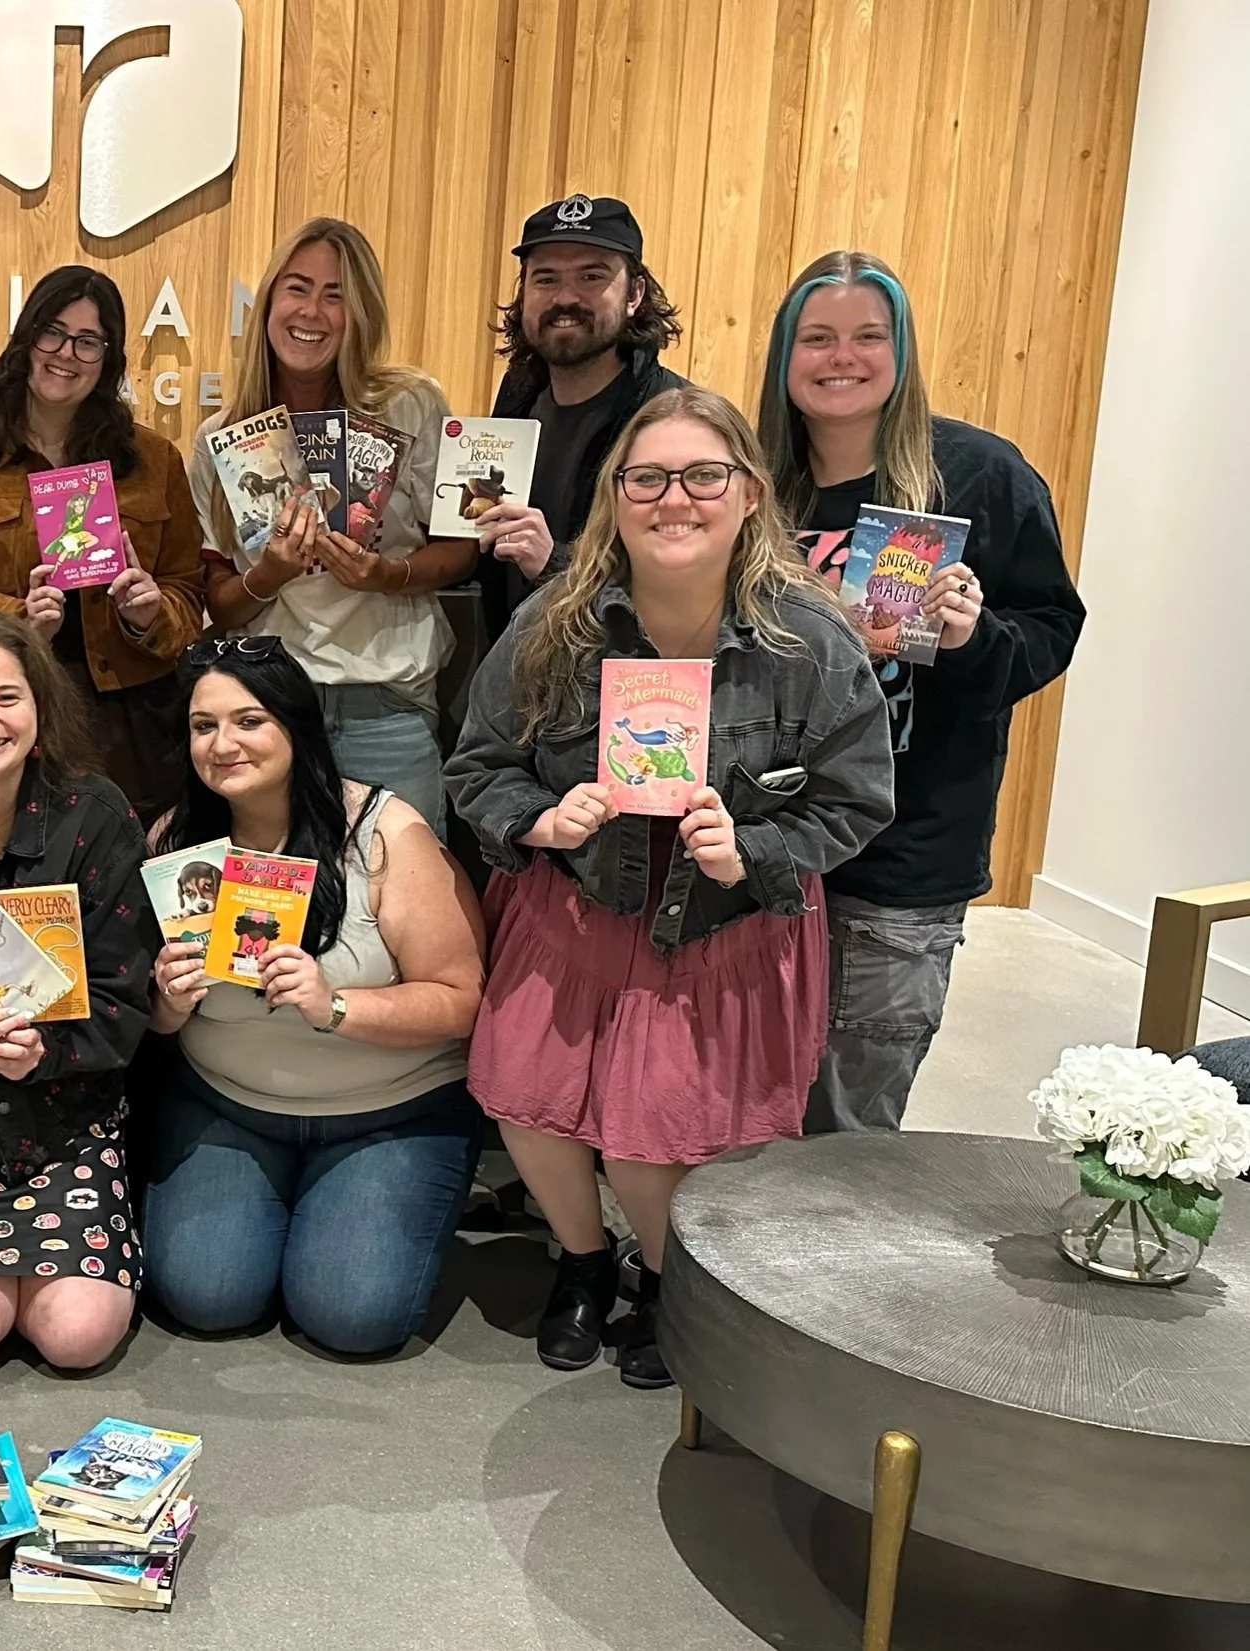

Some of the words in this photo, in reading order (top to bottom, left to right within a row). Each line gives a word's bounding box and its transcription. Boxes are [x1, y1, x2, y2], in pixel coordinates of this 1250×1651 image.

[210, 432, 242, 454] G.I.
[243, 412, 289, 439] DOGS
[234, 432, 270, 451] PRISONER
[249, 442, 266, 453] WAR
[459, 435, 515, 450] Christopher
[470, 447, 504, 463] Robin
[33, 482, 55, 494] DEAR
[56, 478, 79, 491] DUMB
[878, 552, 929, 578] SNICKER
[893, 569, 906, 583] of
[870, 578, 925, 605] MAGIC
[887, 640, 910, 652] LLOYD
[610, 669, 670, 697] Secret
[622, 686, 699, 711] Mermaid
[233, 859, 307, 880] DYAMONDE
[242, 871, 294, 889] DANIEL
[34, 896, 72, 916] CLEARY
[45, 916, 76, 925] MOTHER
[107, 1439, 158, 1457] MAGIC
